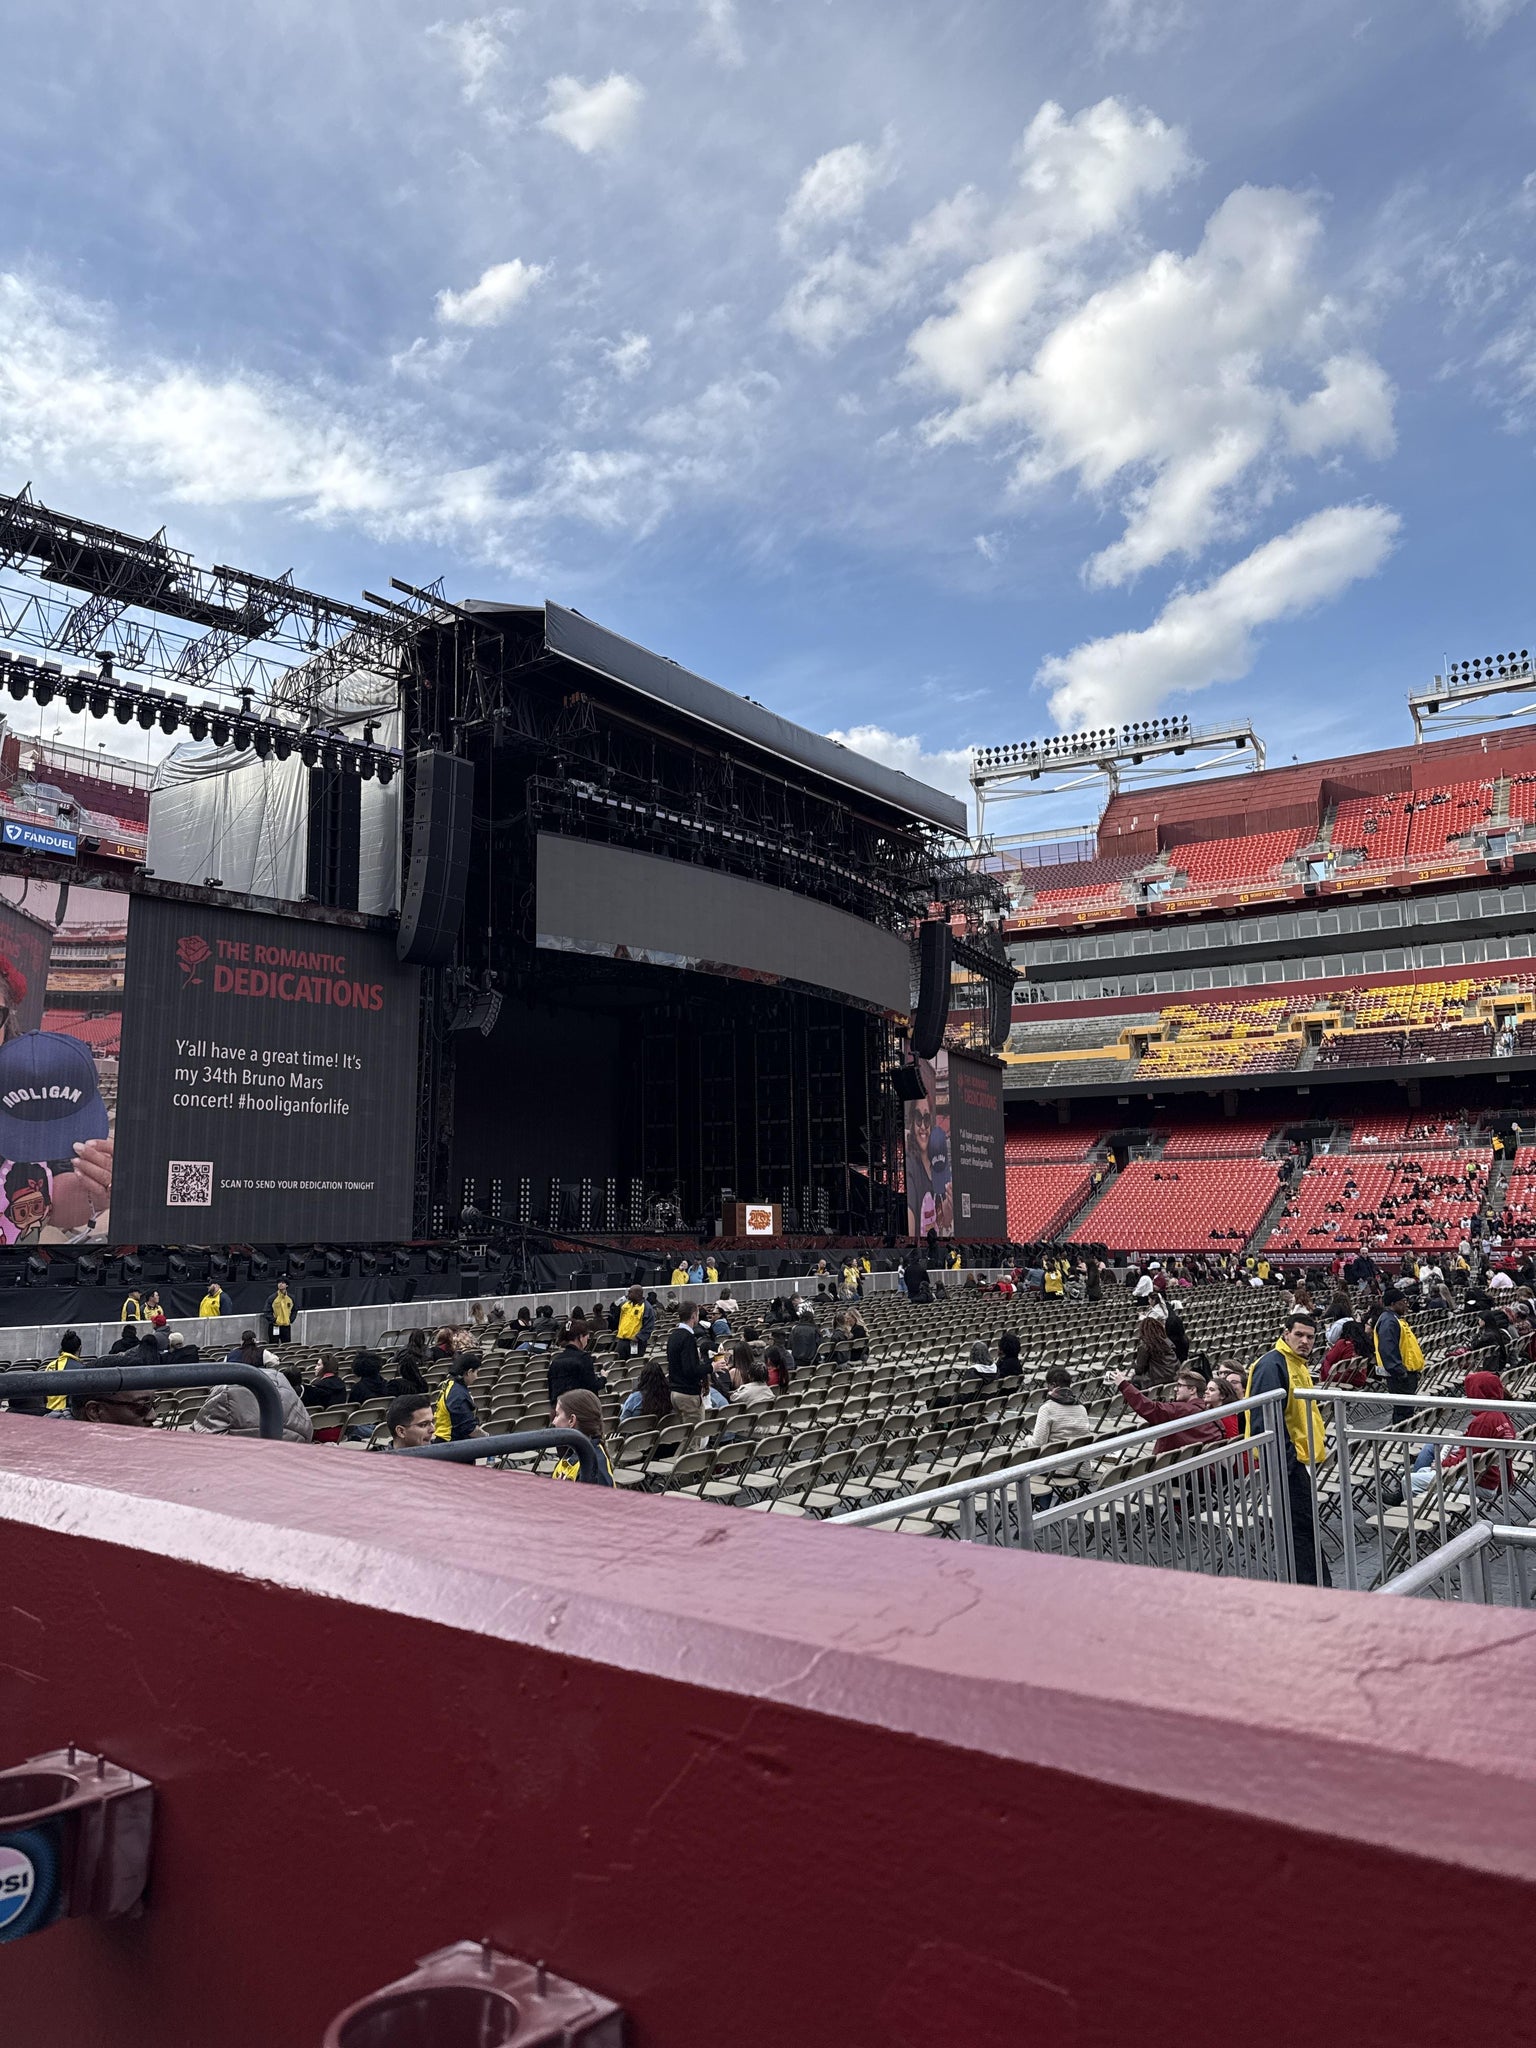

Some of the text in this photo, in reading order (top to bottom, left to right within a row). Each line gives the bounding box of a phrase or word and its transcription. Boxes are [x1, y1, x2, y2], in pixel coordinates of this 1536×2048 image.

[24, 831, 75, 850] FANDUEL
[116, 845, 125, 855] 14
[1418, 870, 1429, 880] 33
[1336, 882, 1342, 890] 9
[1239, 894, 1249, 902] 49
[1166, 902, 1176, 911] 72
[1017, 919, 1027, 927] 70
[1077, 913, 1087, 921] 42
[216, 939, 346, 974] THE ROMANTIC
[213, 964, 384, 1011] DEDICATIONS
[176, 1039, 361, 1070] Y'all have a great time! It's
[174, 1066, 324, 1090] my 34th Bruno Mars
[2, 1085, 82, 1108] HOOLIGAN
[173, 1093, 350, 1117] concert! #hooliganforlife
[220, 1179, 375, 1191] SCAN TO SEND YOUR DEDICATION TONIGHT
